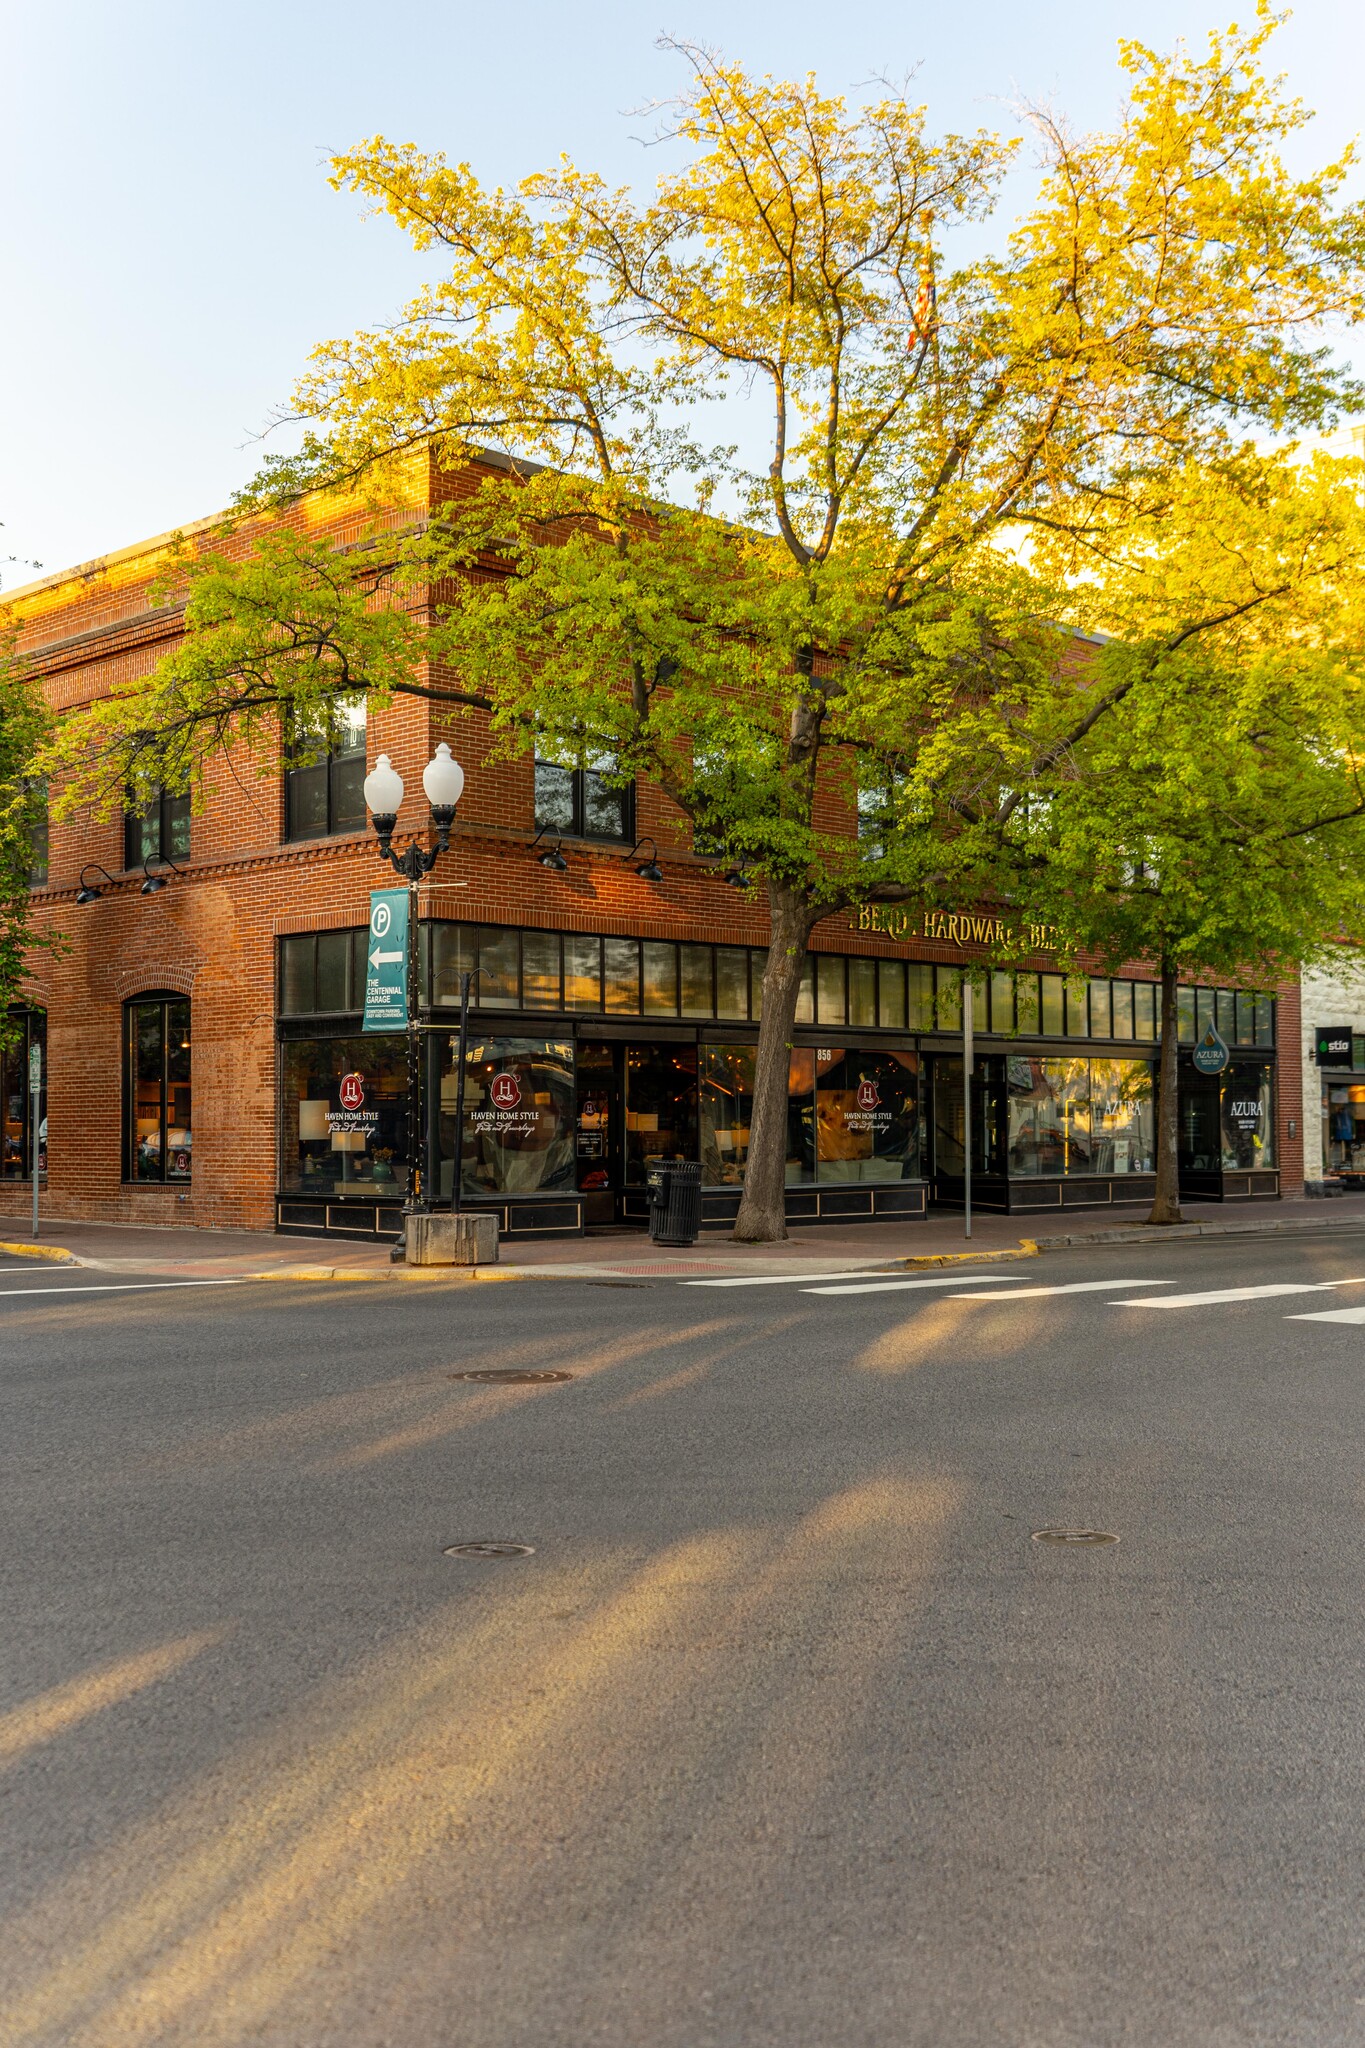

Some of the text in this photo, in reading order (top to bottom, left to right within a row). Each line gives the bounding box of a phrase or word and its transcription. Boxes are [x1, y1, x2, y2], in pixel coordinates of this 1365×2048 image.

[1030, 924, 1070, 951] BLD
[367, 979, 379, 987] THE
[367, 986, 403, 995] CENTENNIAL
[366, 995, 391, 1004] GARAGE
[817, 1049, 832, 1061] 856
[1230, 1100, 1263, 1116] AZURÁ
[324, 1112, 379, 1121] HAVEN HOME STYLE
[470, 1111, 539, 1120] HAVEN HOME STYLE
[843, 1112, 892, 1120] HAVEN HOME STYLE
